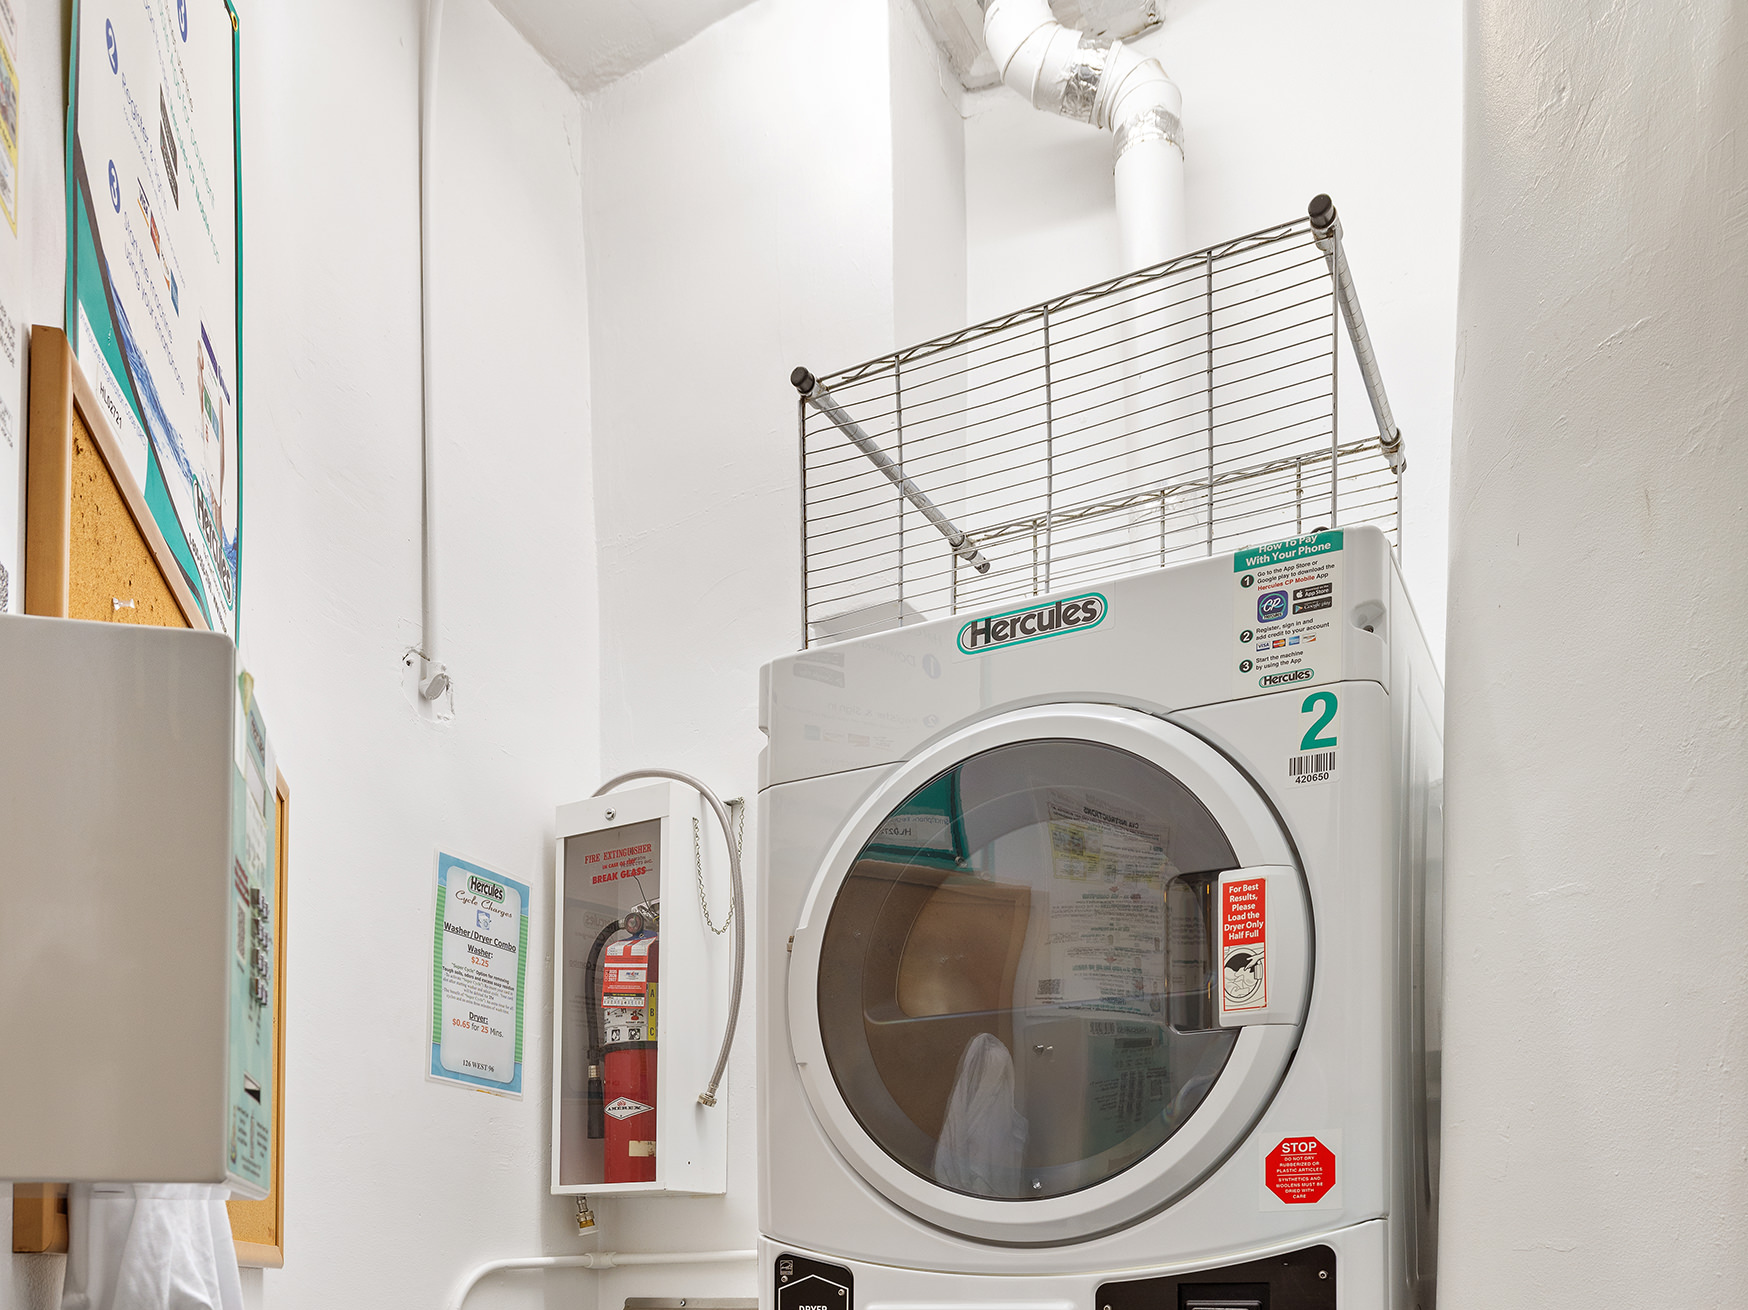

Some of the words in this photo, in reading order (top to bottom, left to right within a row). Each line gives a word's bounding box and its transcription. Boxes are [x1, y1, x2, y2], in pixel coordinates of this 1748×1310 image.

[100, 382, 122, 429] HL02721
[1258, 542, 1282, 554] How
[1286, 539, 1298, 548] To
[1298, 534, 1318, 545] Pay
[1246, 553, 1271, 567] With
[1273, 550, 1296, 562] Your
[1298, 542, 1331, 556] Phone
[1283, 565, 1295, 573] App
[1296, 562, 1310, 570] Store
[1244, 576, 1250, 586] 1
[1257, 575, 1277, 585] Google
[1278, 573, 1290, 582] play
[1297, 565, 1324, 576] download
[1257, 581, 1283, 591] Hercules
[1285, 578, 1294, 586] CP
[1295, 574, 1315, 584] Mobile
[1316, 572, 1328, 580] App
[971, 600, 1097, 648] Hercules
[1256, 625, 1281, 634] Register,
[1244, 632, 1250, 641] 2
[1256, 633, 1266, 641] add
[1268, 630, 1284, 638] credit
[1292, 627, 1305, 635] your
[1306, 622, 1329, 631] account
[1256, 656, 1269, 664] Start
[1280, 651, 1303, 659] machine
[1243, 662, 1250, 671] 3
[1264, 661, 1279, 669] using
[1263, 670, 1311, 686] Hercules
[1300, 691, 1338, 751] 2
[1295, 772, 1329, 784] 420650
[584, 853, 600, 864] FIRE
[603, 843, 652, 861] EXTINGUISHER
[592, 871, 618, 885] BREAK
[620, 866, 646, 879] GLASS
[470, 876, 503, 900] Hercules
[1229, 886, 1241, 894] For
[1243, 883, 1259, 892] Best
[455, 890, 478, 904] Cycle
[481, 899, 512, 918] Charges
[1230, 893, 1258, 903] Results,
[1232, 903, 1256, 912] Please
[1228, 912, 1246, 921] Load
[1247, 911, 1260, 919] the
[1224, 923, 1245, 932] Dryer
[1246, 920, 1264, 929] Only
[444, 921, 493, 943] Washer/Dryer
[493, 938, 516, 952] Combo
[1229, 931, 1244, 941] Half
[1245, 930, 1259, 939] Full
[467, 944, 493, 959] Washer:
[471, 956, 489, 968] $2.25
[650, 989, 655, 997] A
[469, 1011, 488, 1024] Dryer:
[650, 1008, 654, 1016] B
[452, 1018, 470, 1029] $0.65
[471, 1022, 479, 1031] for
[481, 1025, 489, 1034] 25
[490, 1027, 504, 1038] Mins.
[462, 1059, 471, 1067] 126
[472, 1061, 488, 1071] WEST
[1282, 1142, 1317, 1153] STOP
